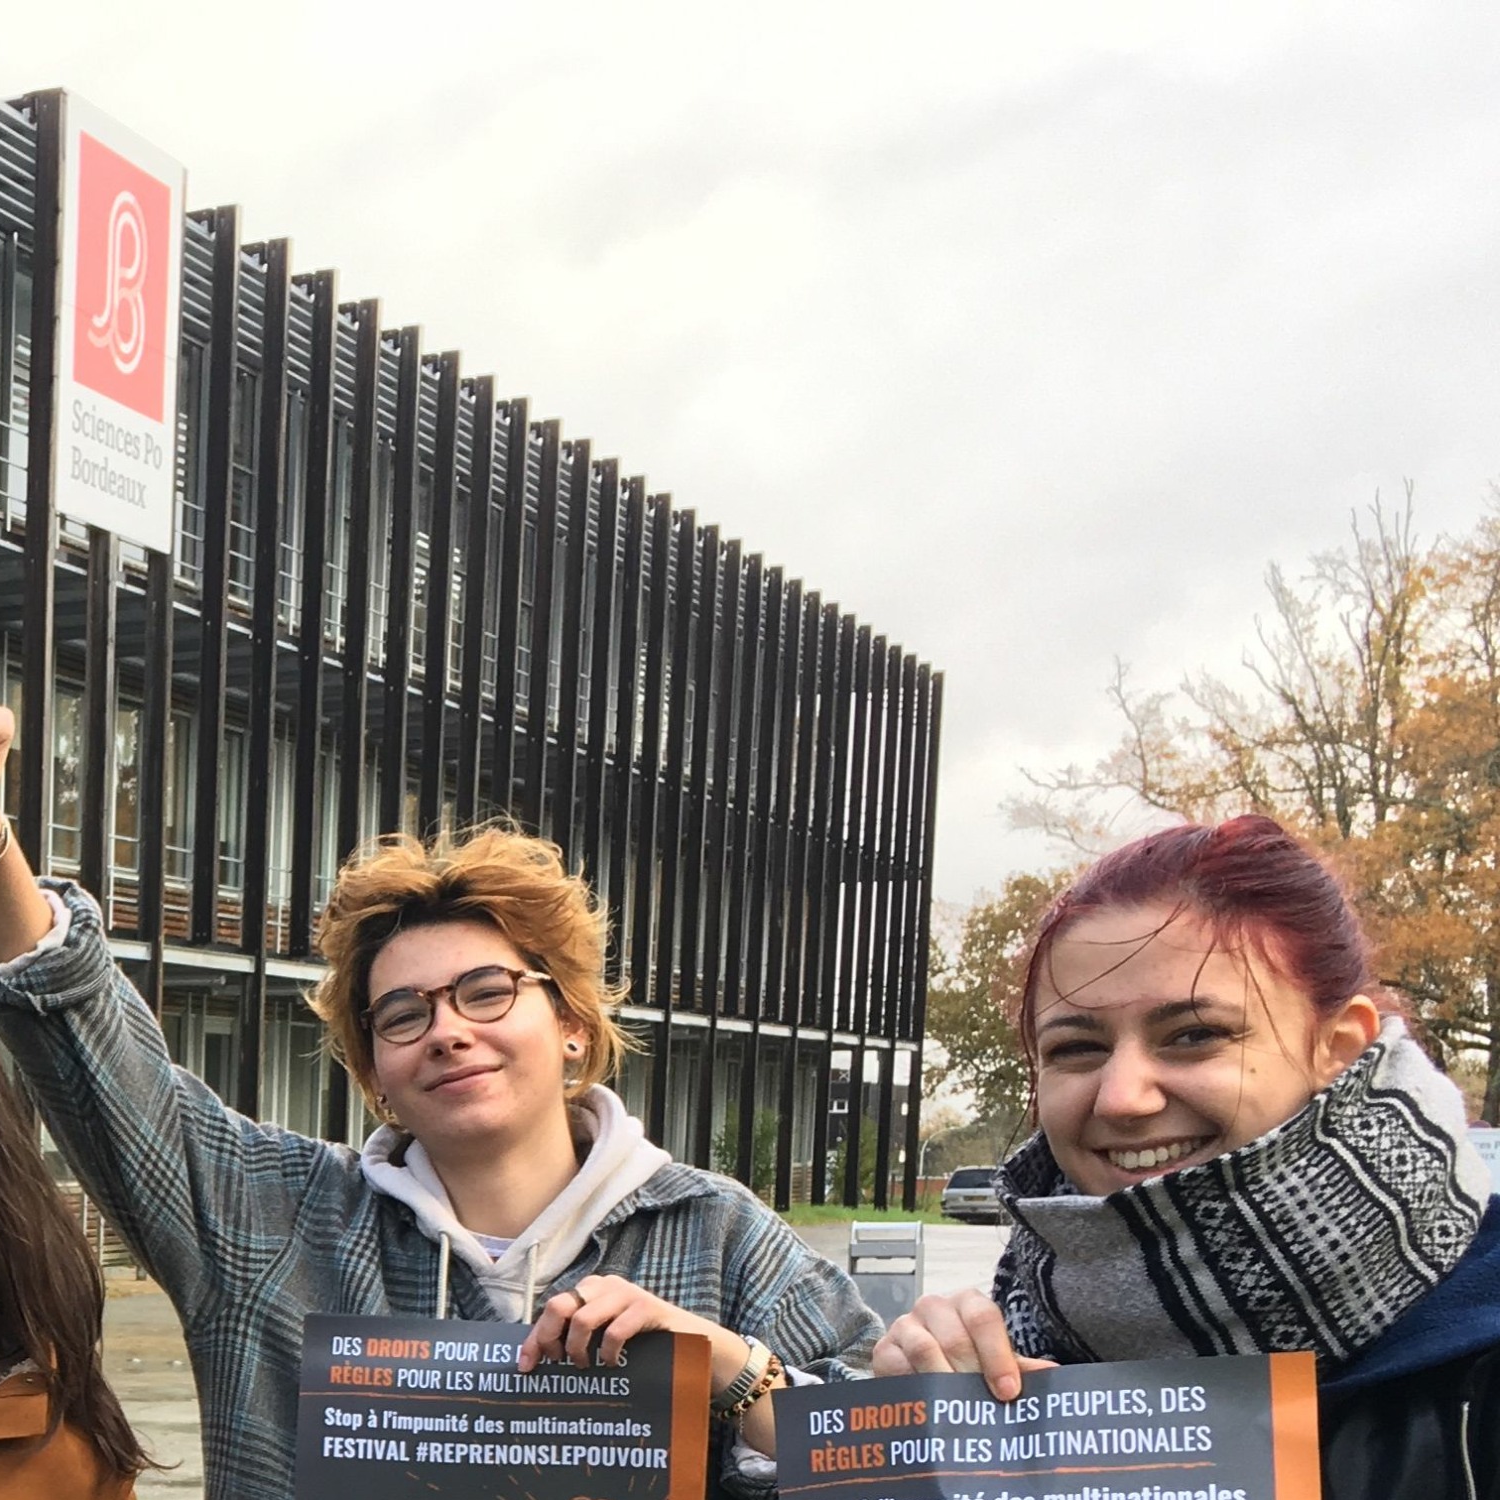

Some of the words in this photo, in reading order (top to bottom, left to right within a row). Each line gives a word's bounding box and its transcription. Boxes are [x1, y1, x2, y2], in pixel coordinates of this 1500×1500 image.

[72, 399, 140, 459] Sciences
[143, 432, 162, 470] Po
[71, 446, 147, 508] Bordeaux
[332, 1336, 362, 1357] DES
[367, 1339, 429, 1358] DROITS
[434, 1340, 480, 1362] POUR
[483, 1343, 512, 1363] LES
[596, 1347, 628, 1367] DS
[330, 1361, 393, 1387] RÈGLES
[397, 1368, 442, 1390] POUR
[446, 1370, 474, 1391] LES
[478, 1372, 630, 1396] MULTINATIONALES
[324, 1406, 363, 1431] Stop
[367, 1408, 378, 1428] à
[382, 1410, 469, 1434] l'impunité
[474, 1414, 505, 1434] des
[510, 1416, 652, 1438] multinationales
[810, 1408, 845, 1436] DES
[850, 1401, 927, 1432] DROITS
[934, 1399, 996, 1426] POUR
[1004, 1396, 1040, 1425] LES
[1046, 1388, 1154, 1418] PEUPLES,
[1160, 1386, 1206, 1414] DES
[323, 1436, 410, 1462] FESTIVAL
[416, 1441, 668, 1469] #REPRENONSLEPOUVOIR
[811, 1438, 885, 1472] RÈGLES
[890, 1437, 946, 1466] POUR
[953, 1438, 992, 1463] LES
[1000, 1425, 1212, 1462] MULTINATIONALES
